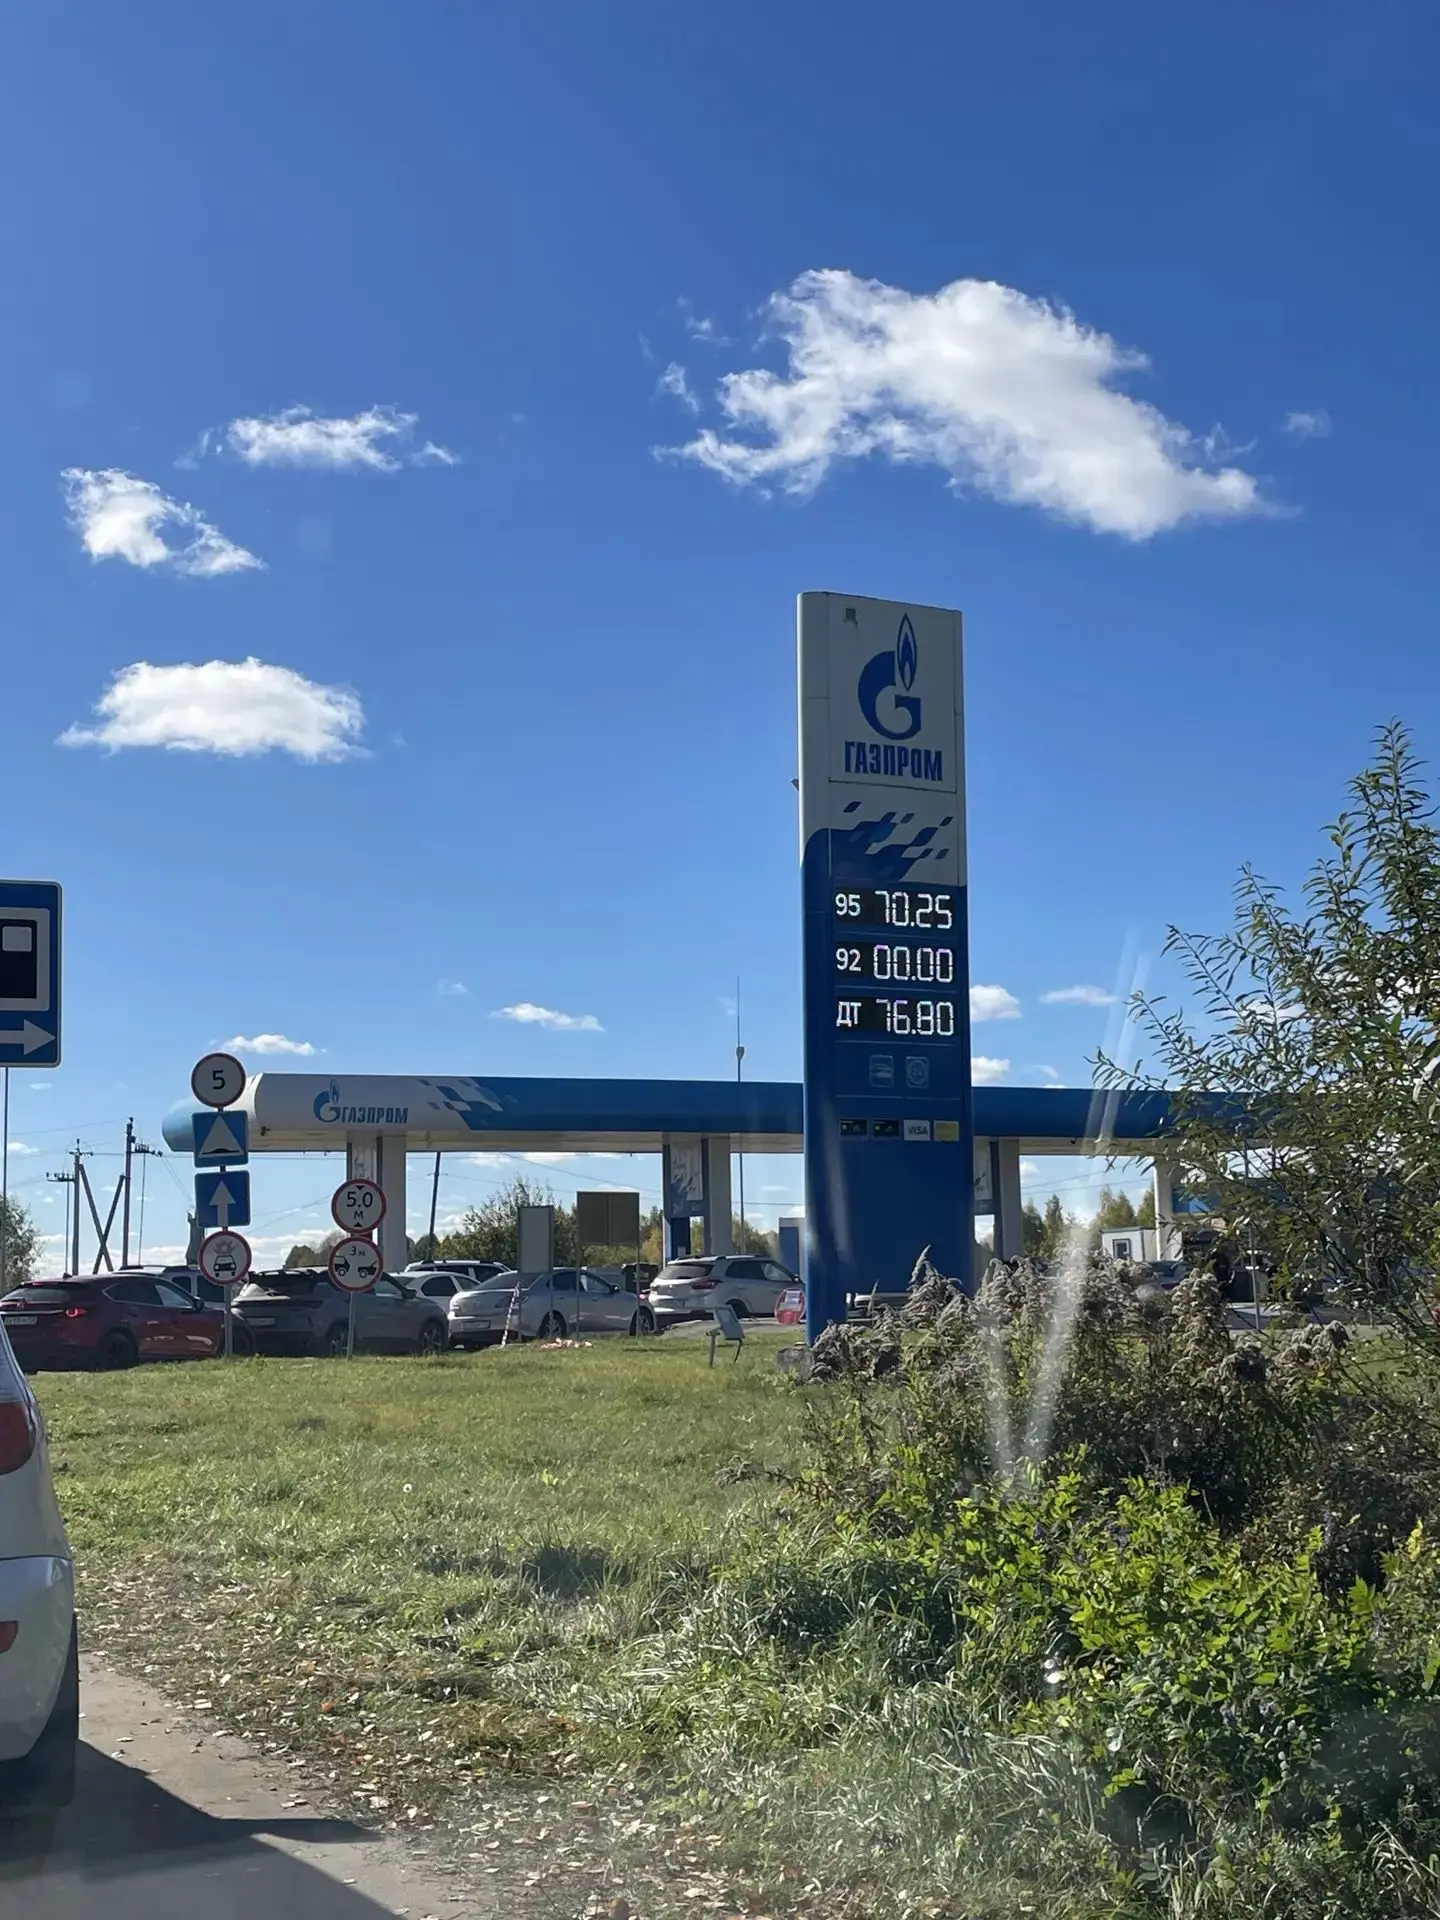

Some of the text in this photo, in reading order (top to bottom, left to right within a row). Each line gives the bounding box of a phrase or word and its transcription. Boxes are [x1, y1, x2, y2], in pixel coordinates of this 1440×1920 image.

[844, 740, 943, 782] ГАЗПРОМ
[835, 890, 953, 929] 95 70.25
[836, 944, 954, 983] 92 00.00
[836, 999, 954, 1036] ДТ 76.80
[212, 1070, 226, 1090] 5
[341, 1106, 408, 1124] ГАЗПРОМ
[907, 1125, 928, 1135] VISA
